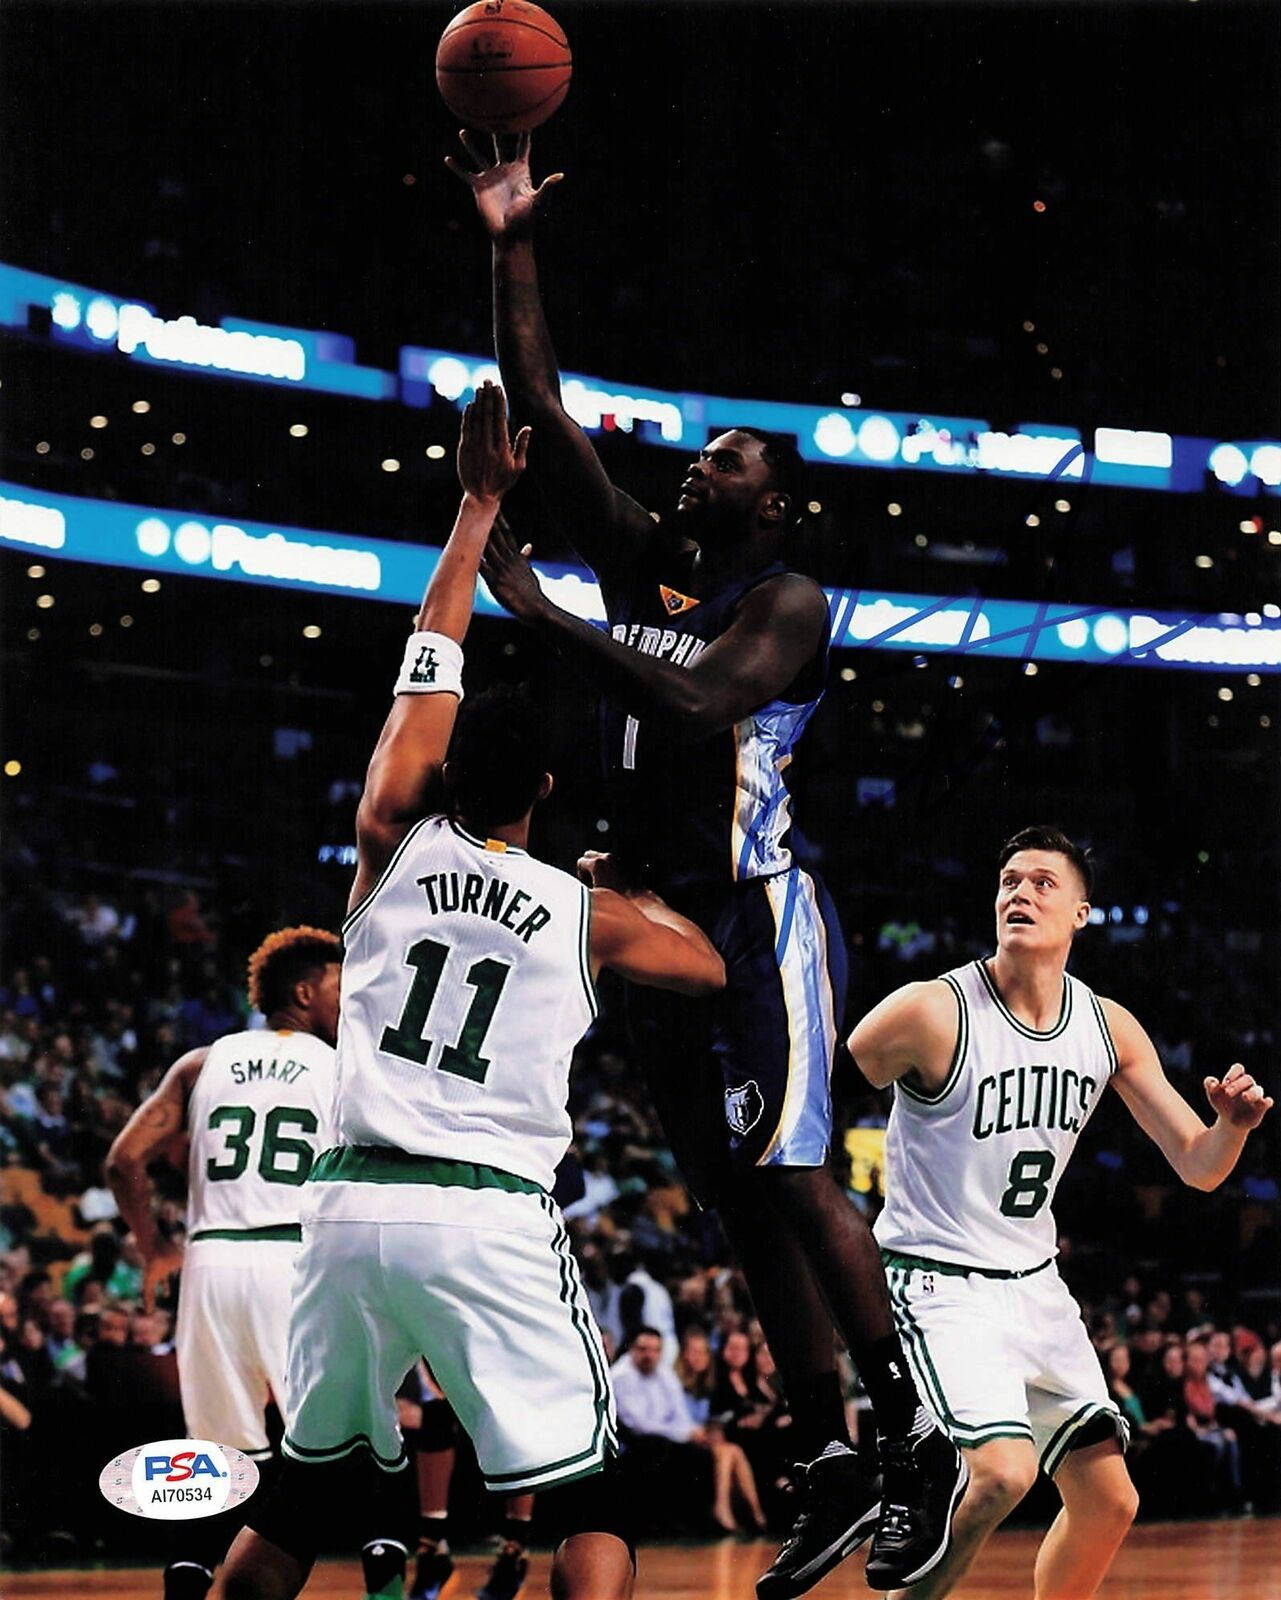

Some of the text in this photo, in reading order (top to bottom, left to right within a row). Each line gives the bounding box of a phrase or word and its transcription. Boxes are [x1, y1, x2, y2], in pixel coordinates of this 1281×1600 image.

[612, 624, 706, 668] MEMPHI
[416, 872, 551, 944] TURNER
[378, 938, 512, 1085] 11
[231, 1059, 310, 1085] SMART
[972, 1065, 1097, 1140] CELTICS
[206, 1105, 319, 1188] 36
[999, 1150, 1056, 1218] 8
[144, 1451, 222, 1482] PSA
[151, 1487, 213, 1504] AI70534
